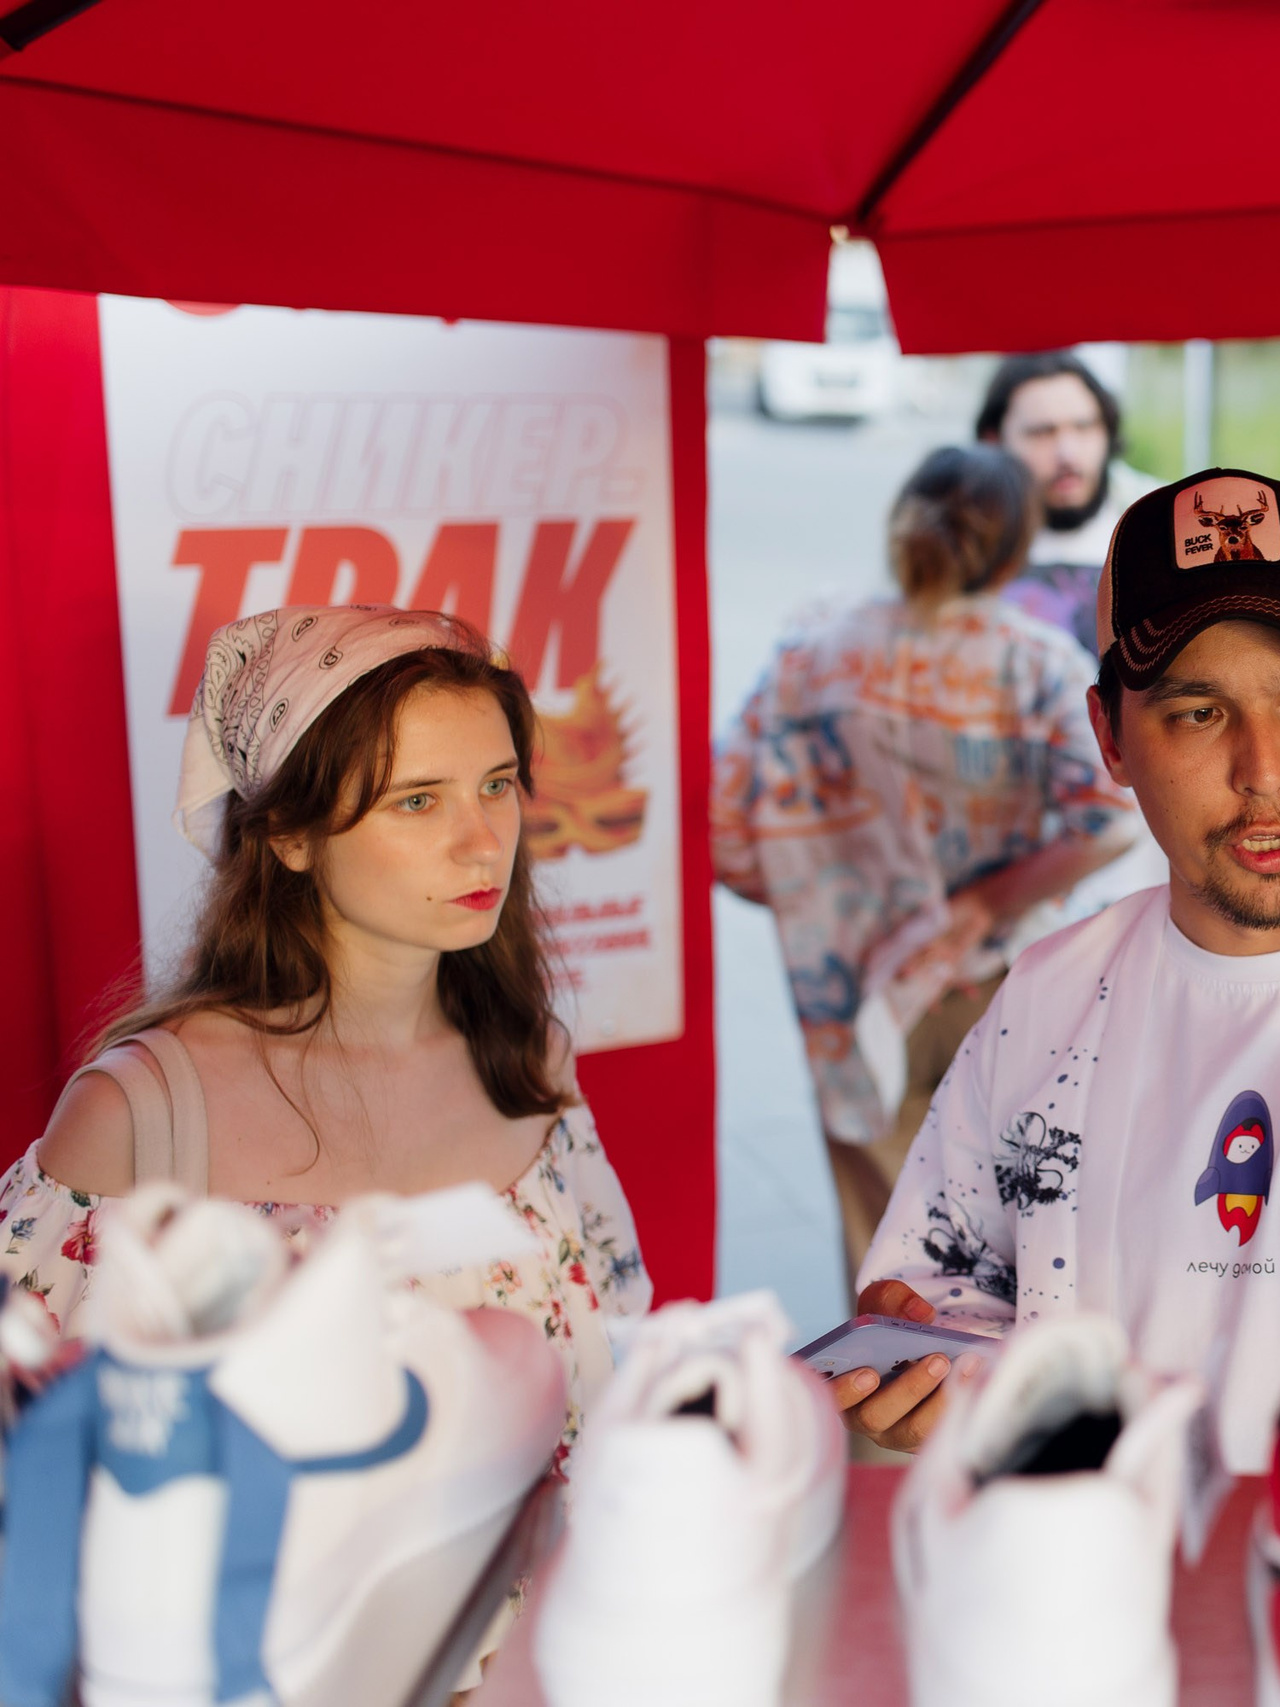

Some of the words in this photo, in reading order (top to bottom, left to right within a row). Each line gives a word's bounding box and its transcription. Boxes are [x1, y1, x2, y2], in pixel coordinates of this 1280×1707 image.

[1184, 533, 1213, 548] BUCK
[1185, 543, 1214, 556] FEVER
[1186, 1261, 1229, 1278] лечу
